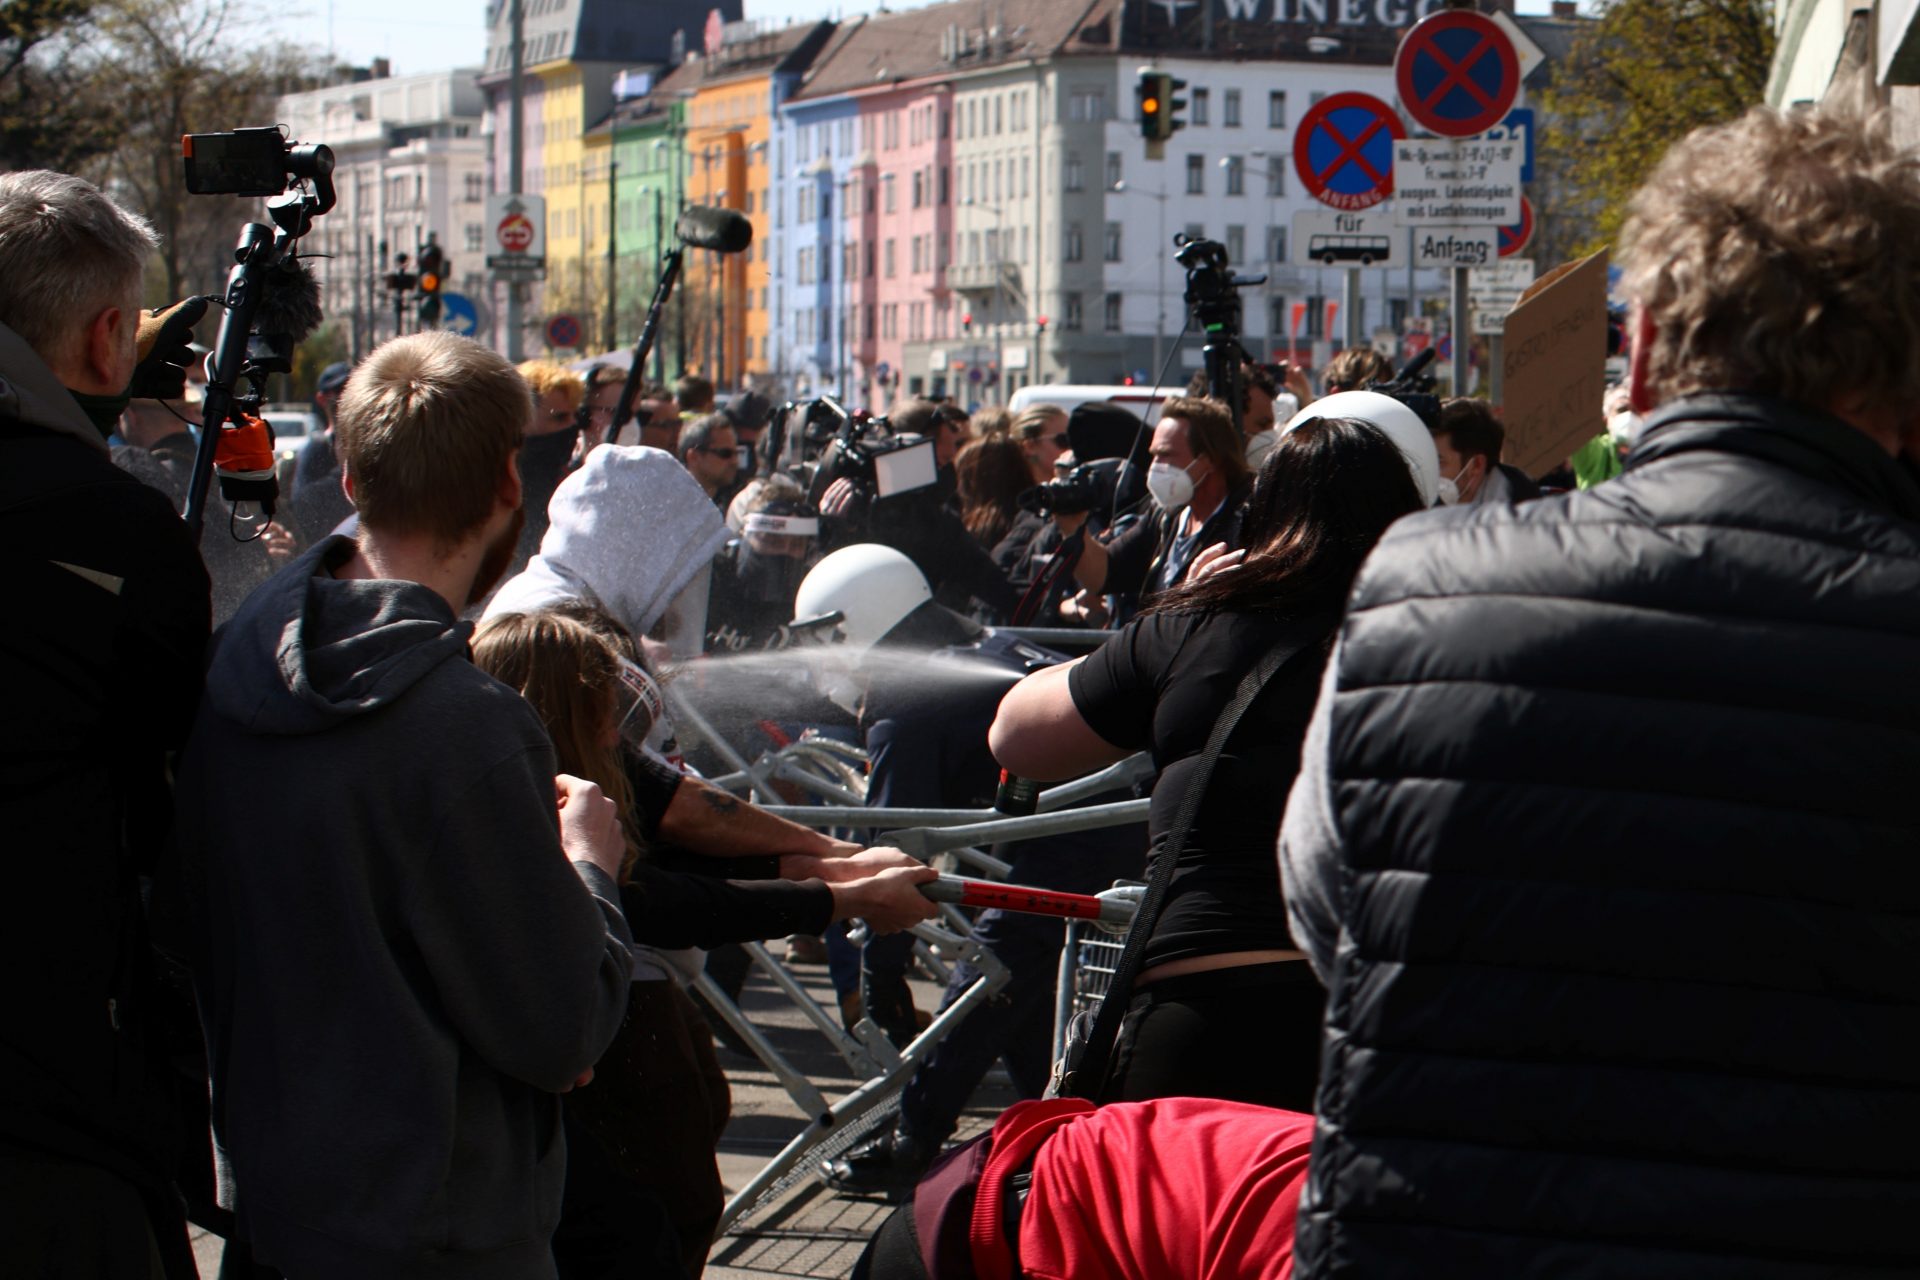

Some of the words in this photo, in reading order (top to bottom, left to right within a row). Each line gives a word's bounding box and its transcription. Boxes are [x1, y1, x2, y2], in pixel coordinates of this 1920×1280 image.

[1318, 187, 1383, 208] ANFANG
[1335, 213, 1365, 232] für
[1422, 234, 1488, 264] Anfang
